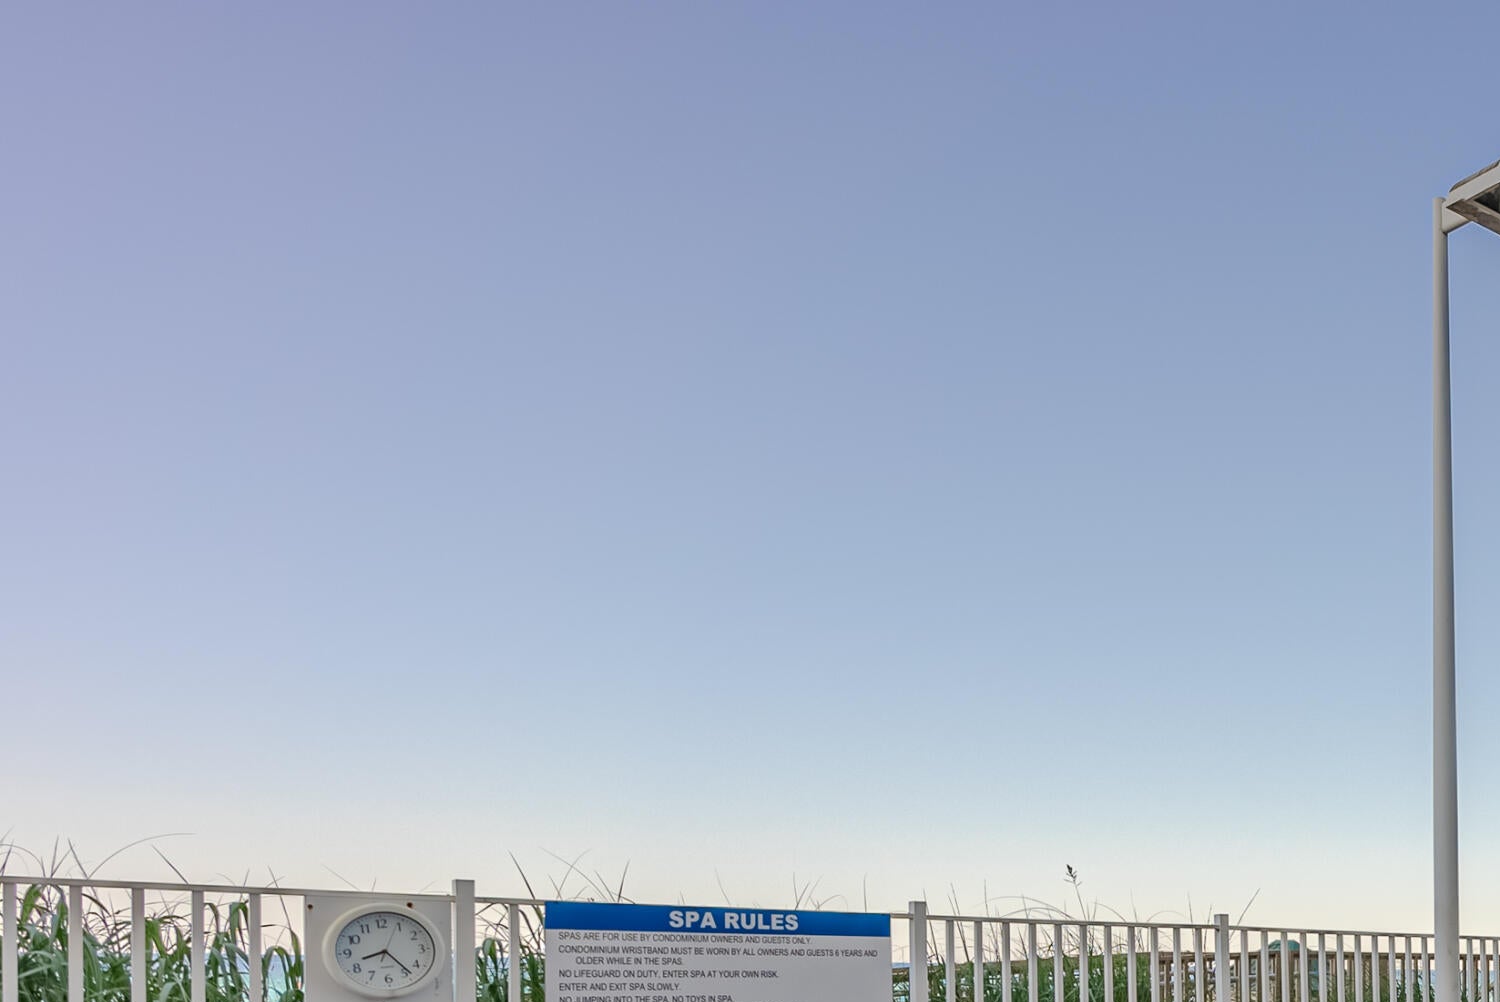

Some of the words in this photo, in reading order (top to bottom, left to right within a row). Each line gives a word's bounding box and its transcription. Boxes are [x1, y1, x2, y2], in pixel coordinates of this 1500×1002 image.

[375, 919, 388, 929] 12
[669, 910, 717, 928] SPA
[725, 912, 799, 931] RULES
[360, 924, 370, 934] 11
[397, 922, 401, 932] 1
[348, 934, 361, 945] 10
[411, 931, 418, 941] 2
[558, 930, 581, 940] SPAS
[582, 931, 600, 940] ARE
[601, 931, 619, 941] FOR
[621, 932, 638, 941] USE
[639, 932, 651, 941] BY
[652, 932, 709, 942] CONDOMINIUM
[710, 933, 743, 943] OWNERS
[744, 934, 760, 943] AND
[761, 934, 791, 943] GUESTS
[343, 949, 352, 959] 9
[418, 944, 426, 954] 3
[352, 963, 361, 974] 8
[412, 960, 420, 969] 4
[368, 970, 376, 981] 7
[558, 969, 572, 977] NO
[573, 969, 621, 977] LIFEGUARD
[622, 969, 635, 977] ON
[661, 969, 688, 977] ENTER
[689, 969, 705, 977] SPA
[706, 969, 716, 977] AT
[718, 969, 740, 977] YOUR
[740, 969, 759, 977] OWN
[384, 974, 393, 984] 6
[558, 982, 587, 991] ENTER
[589, 982, 607, 990] AND
[608, 982, 626, 990] EXIT
[628, 982, 645, 990] SPA
[612, 995, 633, 1002] INTO
[634, 995, 650, 1002] THE
[671, 995, 684, 1002] NO
[685, 994, 706, 1002] TOYS
[707, 994, 716, 1002] IN
